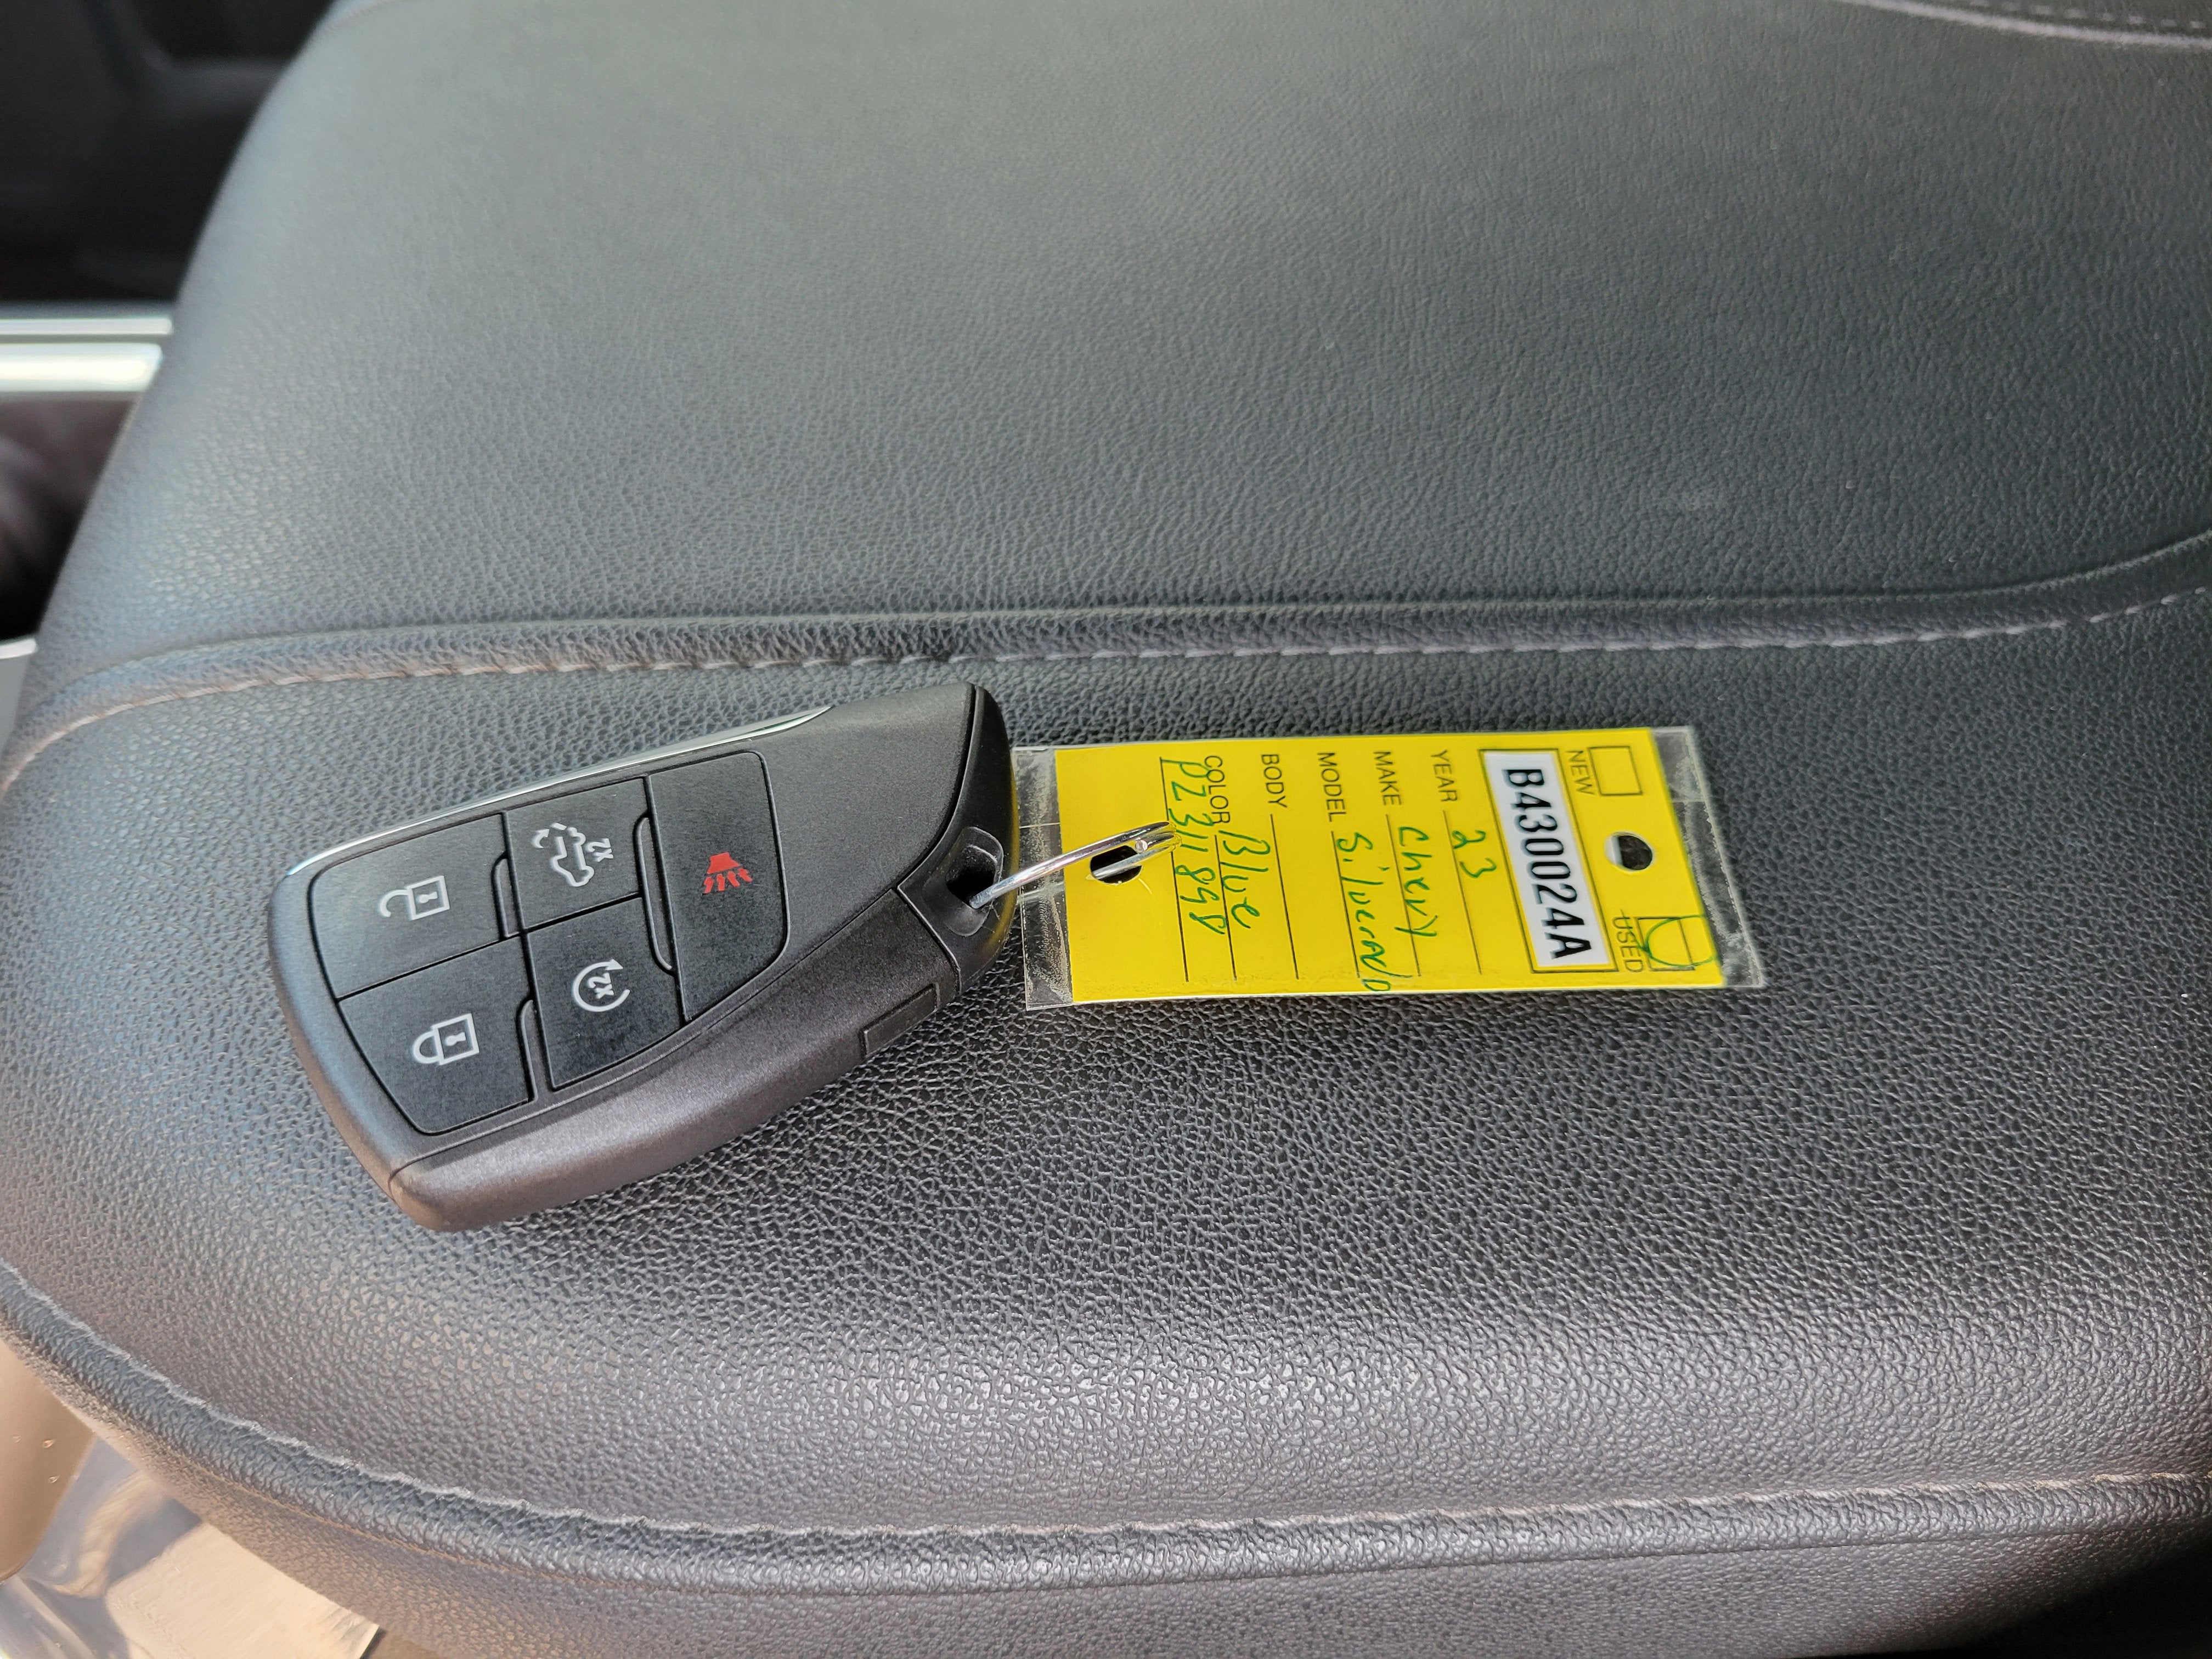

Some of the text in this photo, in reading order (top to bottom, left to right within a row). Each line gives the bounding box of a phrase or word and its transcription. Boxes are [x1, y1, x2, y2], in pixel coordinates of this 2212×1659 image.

[1204, 755, 1231, 824] COLOR
[1261, 753, 1288, 809] BODY
[1317, 752, 1347, 822] MODEL
[1373, 751, 1402, 806] MAKE
[1430, 749, 1458, 802] YEAR
[1566, 750, 1597, 795] NEW
[1218, 830, 1271, 929] Blue
[1394, 826, 1438, 936] Chevy
[1452, 829, 1497, 879] 23
[1502, 768, 1592, 960] B430024A
[1612, 916, 1644, 973] USED
